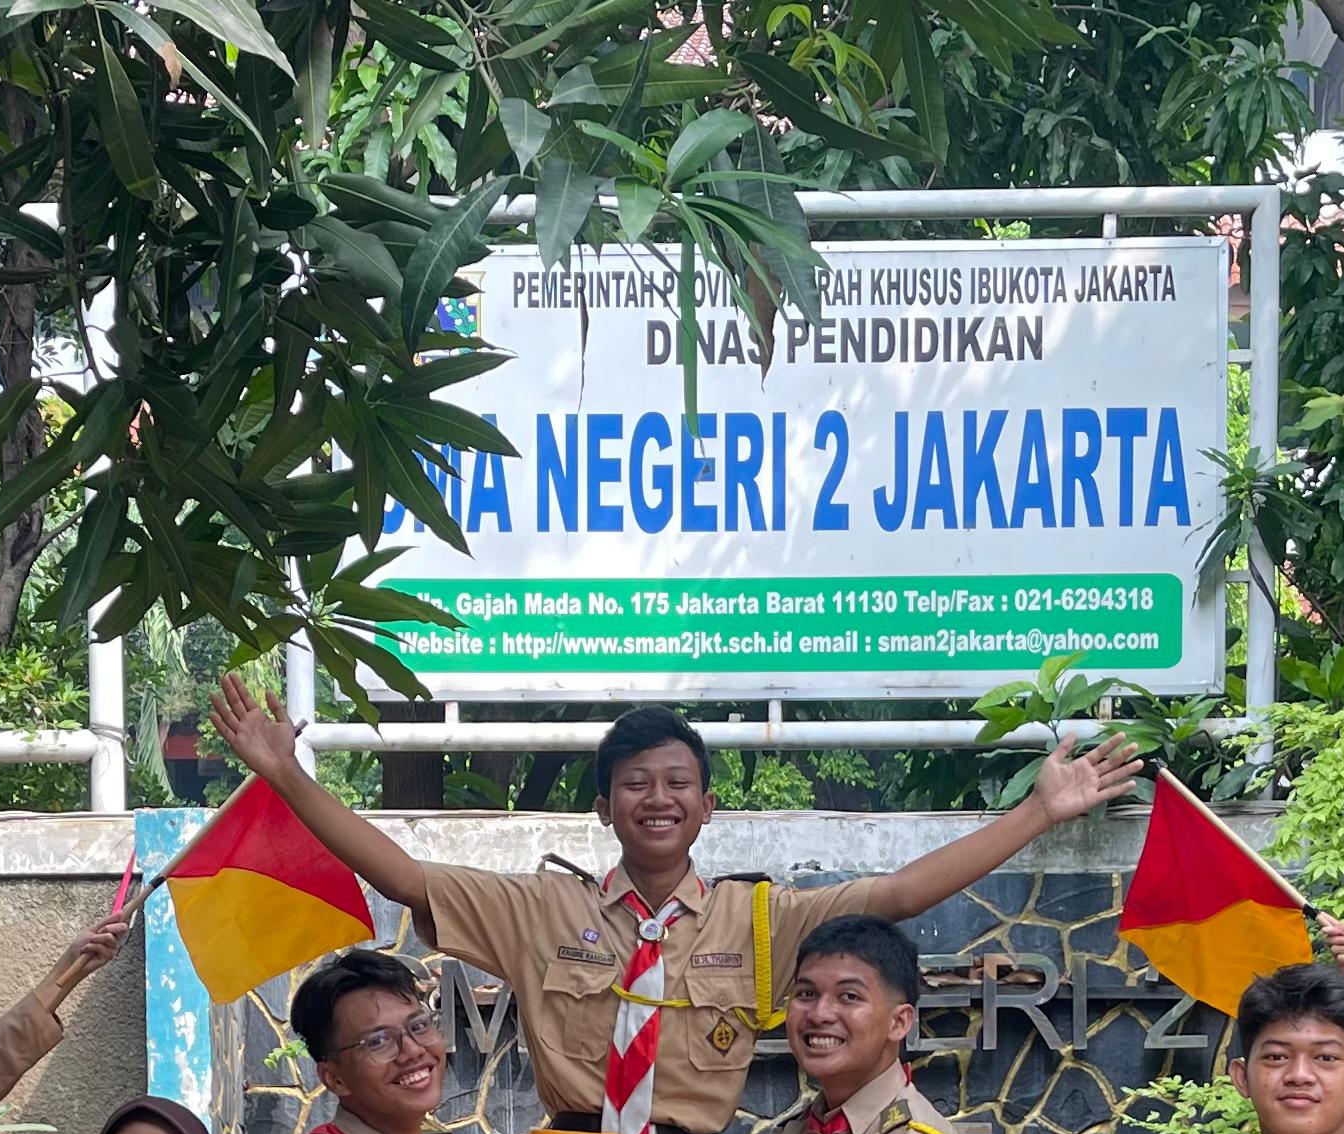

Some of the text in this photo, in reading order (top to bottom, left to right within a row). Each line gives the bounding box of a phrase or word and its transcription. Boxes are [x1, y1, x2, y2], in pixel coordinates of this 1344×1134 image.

[513, 270, 655, 309] PEMERINTAH
[870, 266, 963, 306] KHUSUS
[970, 265, 1067, 304] IBUKOTA
[1074, 264, 1177, 302] JAKARTA
[787, 315, 1044, 363] PENDIDIKAN
[536, 411, 787, 534] NEGERI
[812, 409, 850, 531] 2
[872, 406, 1191, 532] JAKARTA
[455, 592, 518, 621] Gajah
[524, 592, 582, 614] Mada
[588, 592, 624, 614] No.
[630, 592, 670, 614] 175
[675, 591, 759, 614] Jakarta
[766, 591, 824, 613] Barat
[832, 590, 897, 613] 11130
[903, 589, 995, 617] Telp/Fax
[1014, 588, 1154, 611] 021-6294318
[397, 631, 484, 655] Website
[501, 631, 793, 659] http://www.sman2jkt.sch.id
[799, 630, 859, 653] email
[877, 628, 1160, 657] sman2jakarta@yahoo.com
